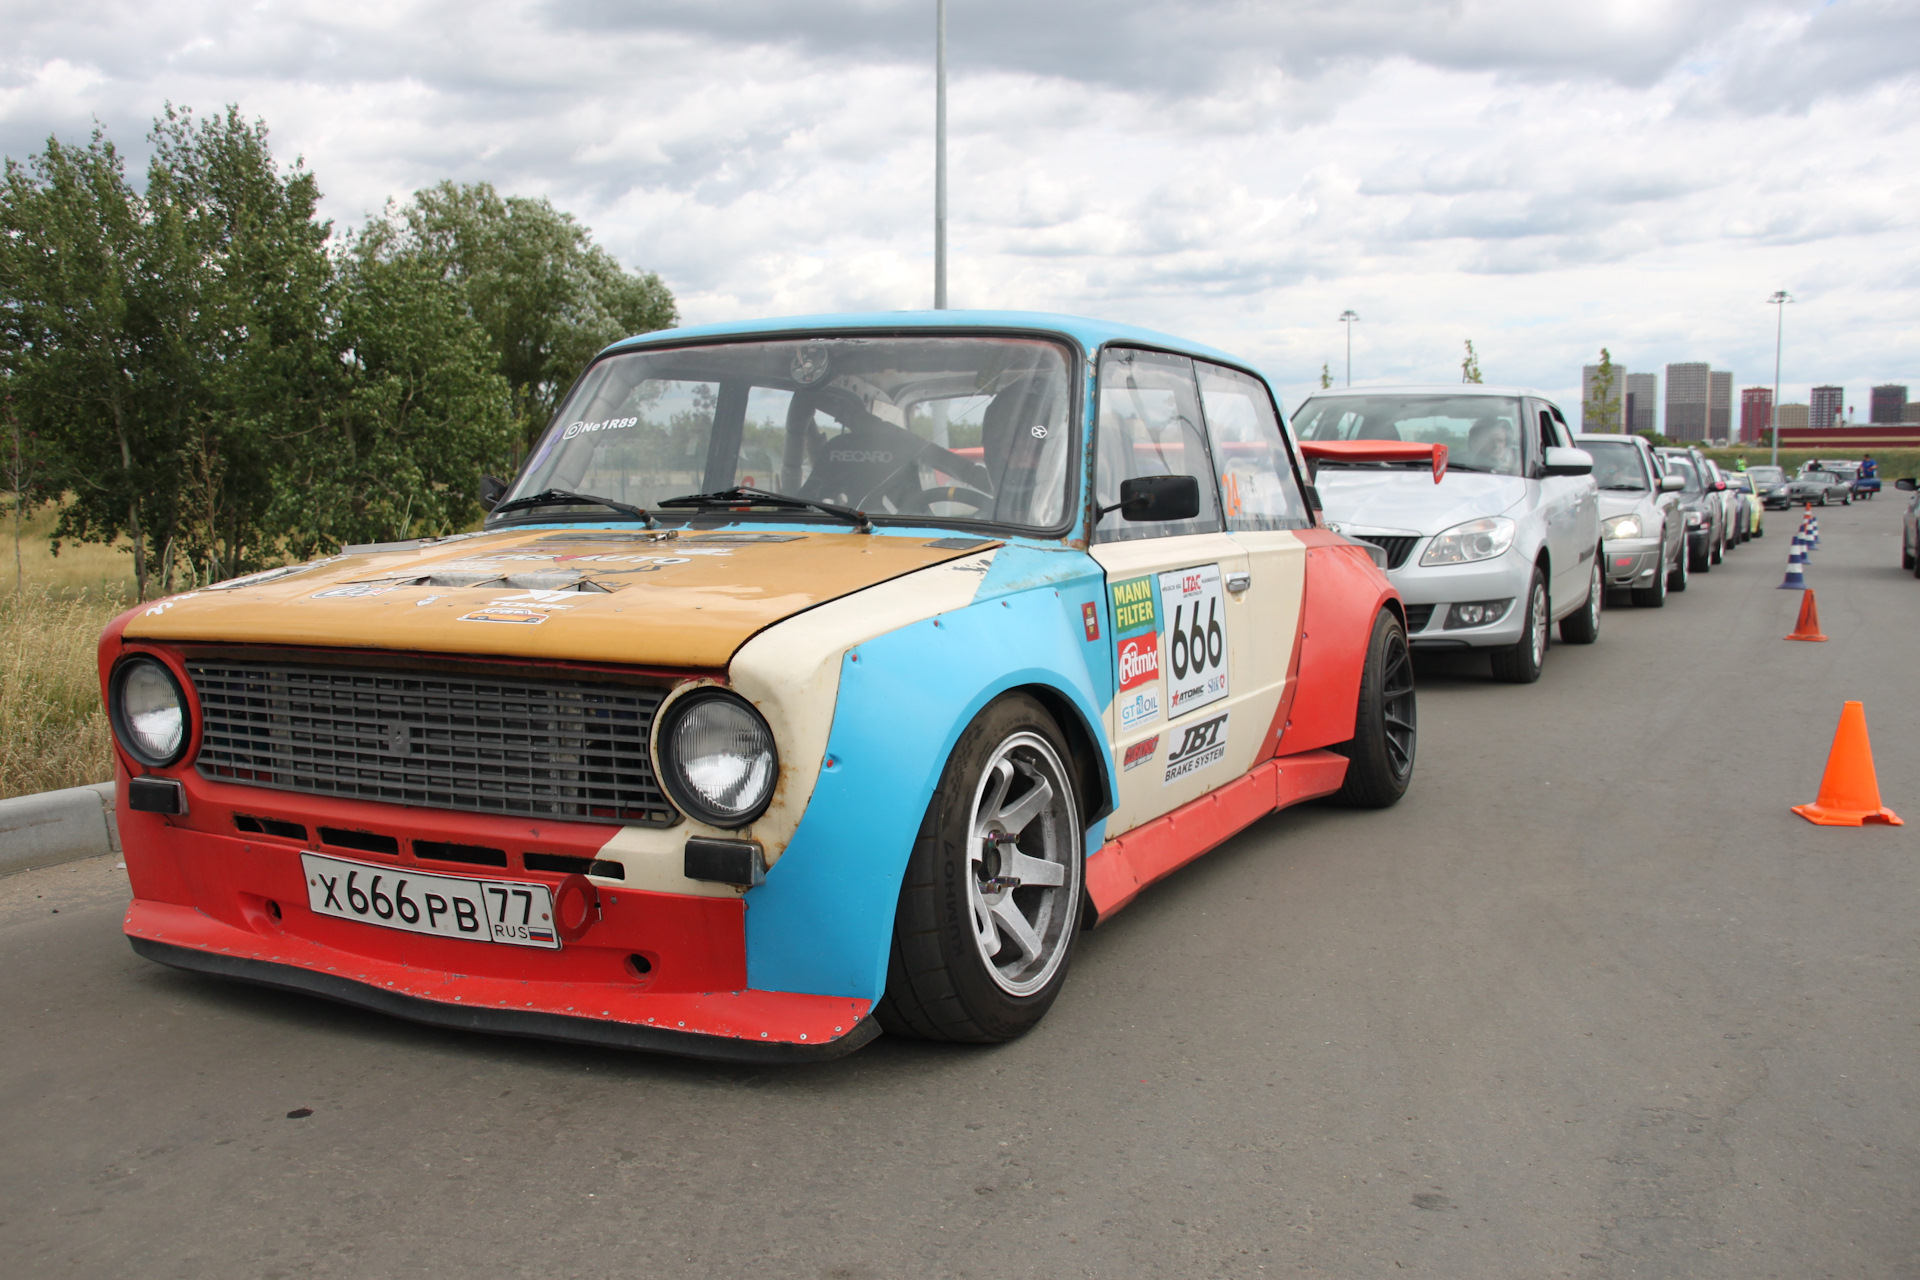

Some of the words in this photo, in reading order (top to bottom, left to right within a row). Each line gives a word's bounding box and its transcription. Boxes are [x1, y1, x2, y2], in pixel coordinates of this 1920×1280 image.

[581, 417, 638, 433] Ne1R89
[830, 450, 893, 463] RECARO
[569, 554, 692, 566] AUTO
[1114, 580, 1151, 606] MANN
[1117, 601, 1154, 628] FILTER
[1171, 596, 1222, 680] 666
[1120, 643, 1158, 683] Ritmix
[1179, 685, 1204, 701] ATOMIC
[1122, 704, 1135, 720] GT
[1144, 696, 1158, 712] OIL
[1169, 713, 1228, 761] JBT
[1165, 760, 1193, 782] BRAKE
[1195, 747, 1225, 768] SYSTEM
[488, 887, 532, 925] 77
[944, 861, 966, 957] KUMHO
[494, 924, 528, 940] RUS
